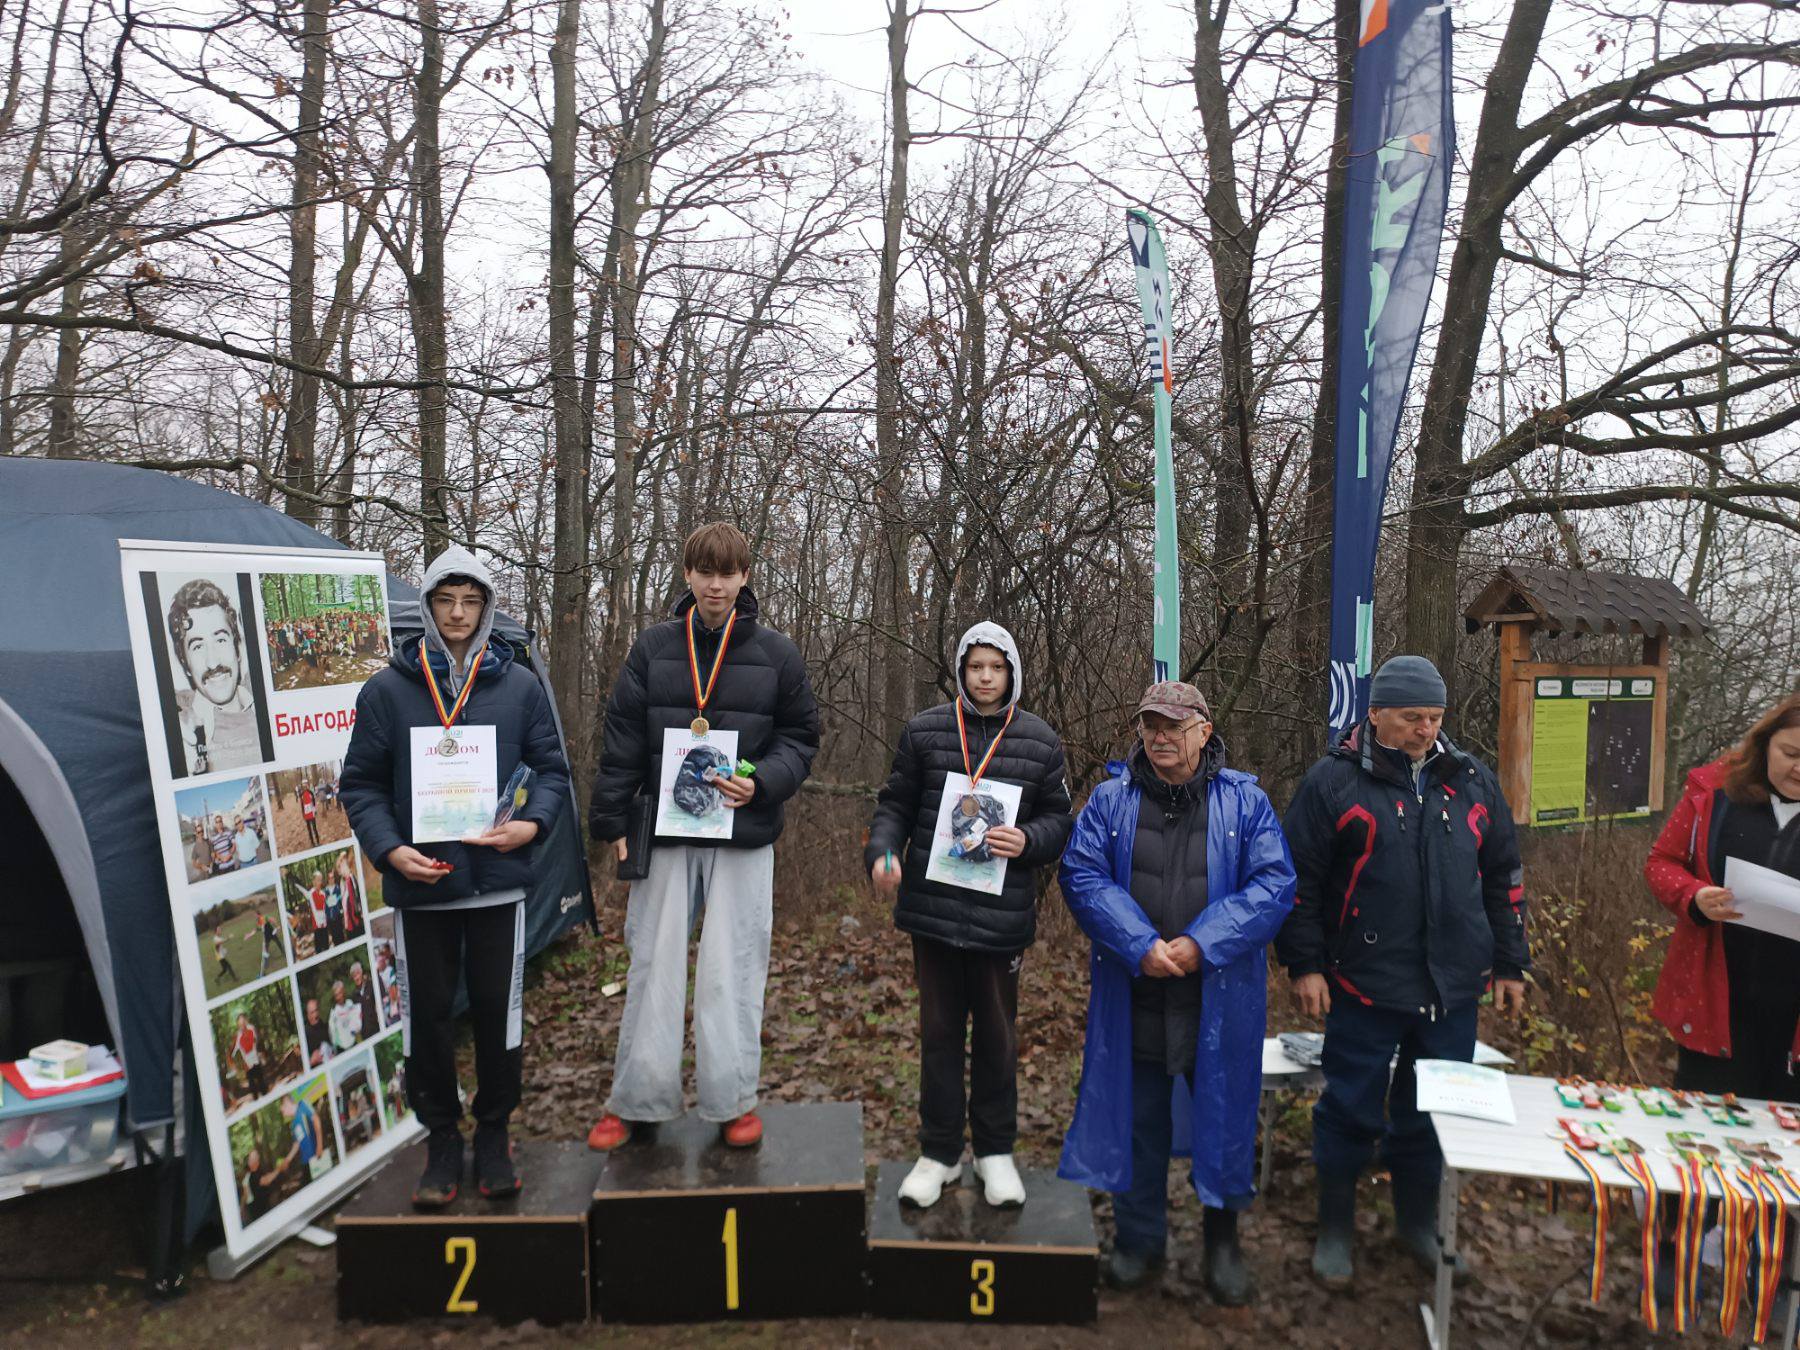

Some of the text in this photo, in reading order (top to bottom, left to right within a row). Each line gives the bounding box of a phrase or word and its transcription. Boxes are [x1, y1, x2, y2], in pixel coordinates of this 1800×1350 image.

[445, 1237, 479, 1313] 2
[722, 1208, 741, 1310] 1
[970, 1260, 996, 1315] 3
